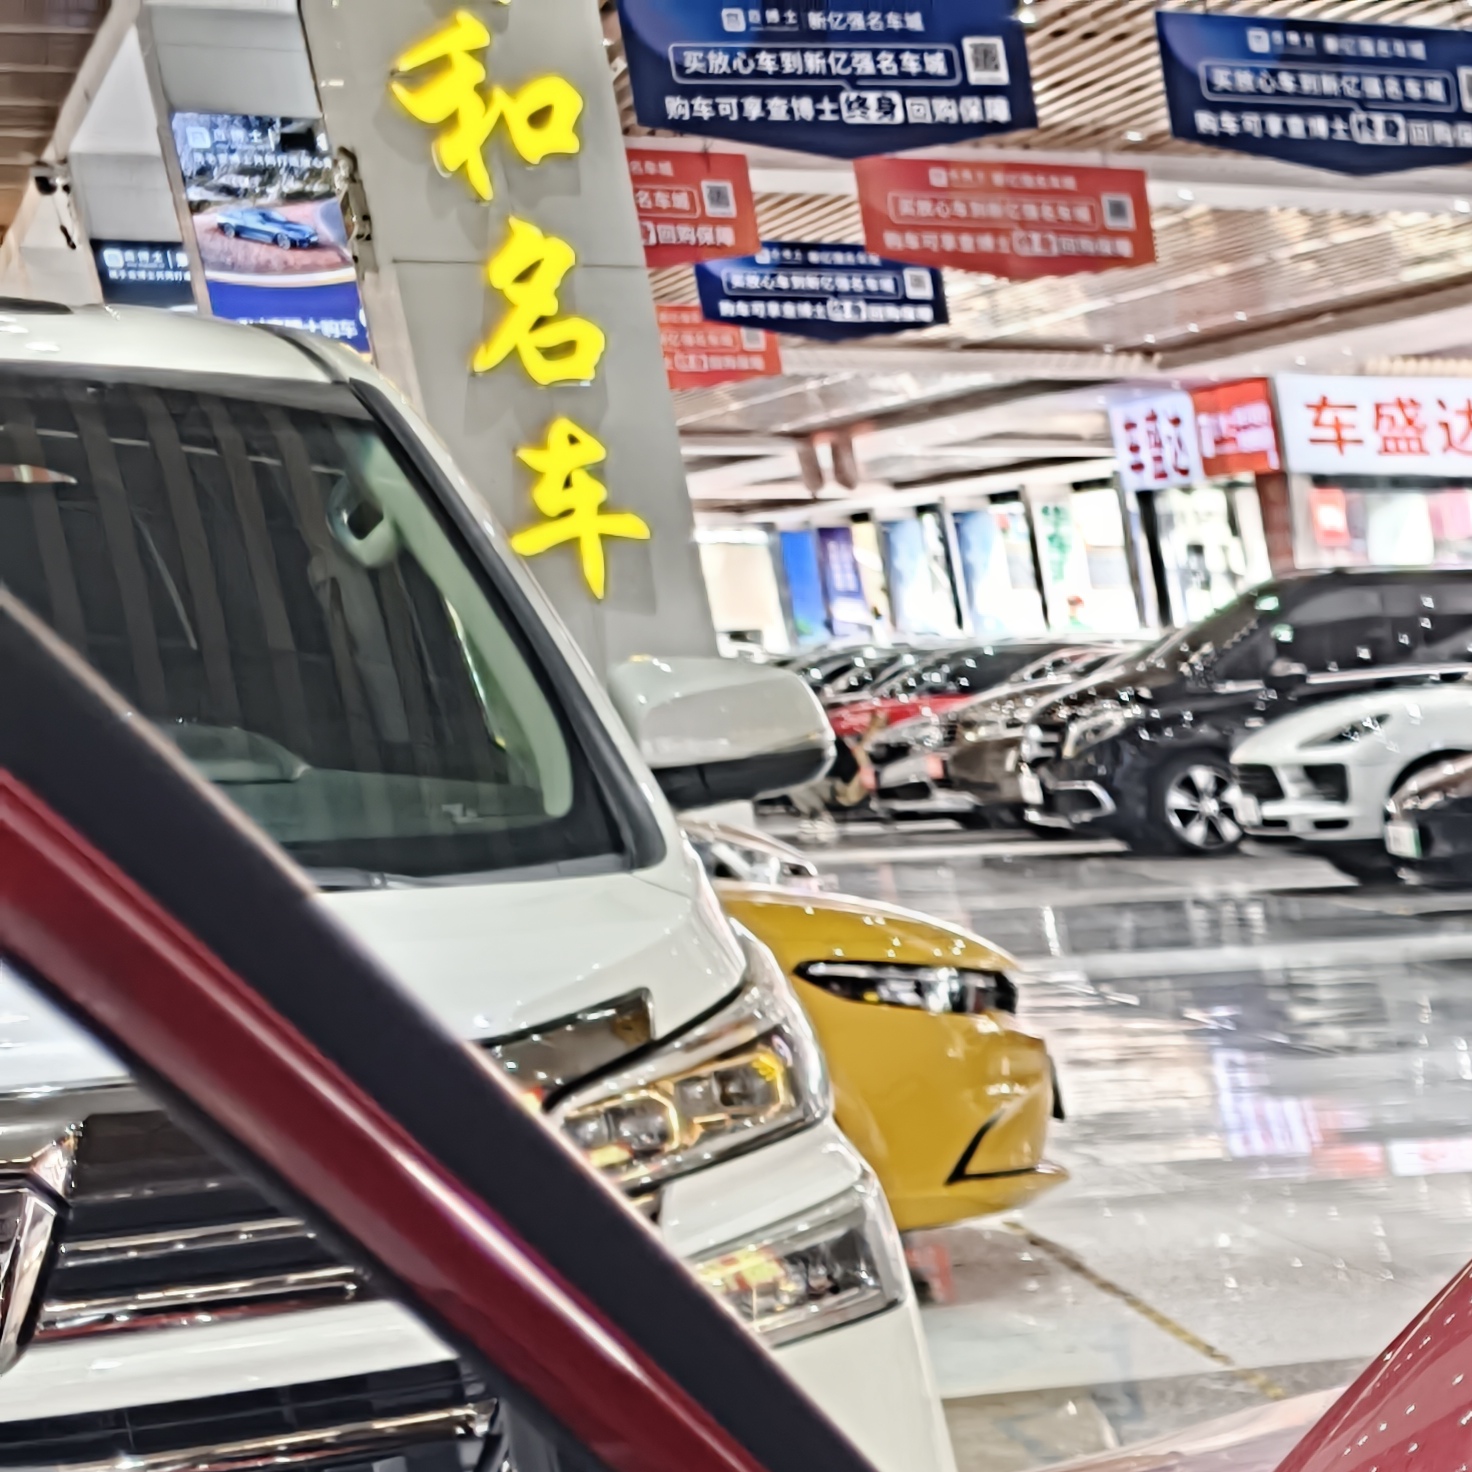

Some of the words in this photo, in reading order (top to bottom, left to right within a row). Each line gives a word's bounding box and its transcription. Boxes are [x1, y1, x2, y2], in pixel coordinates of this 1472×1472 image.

[683, 50, 949, 77] 买放心车到新亿强名车城
